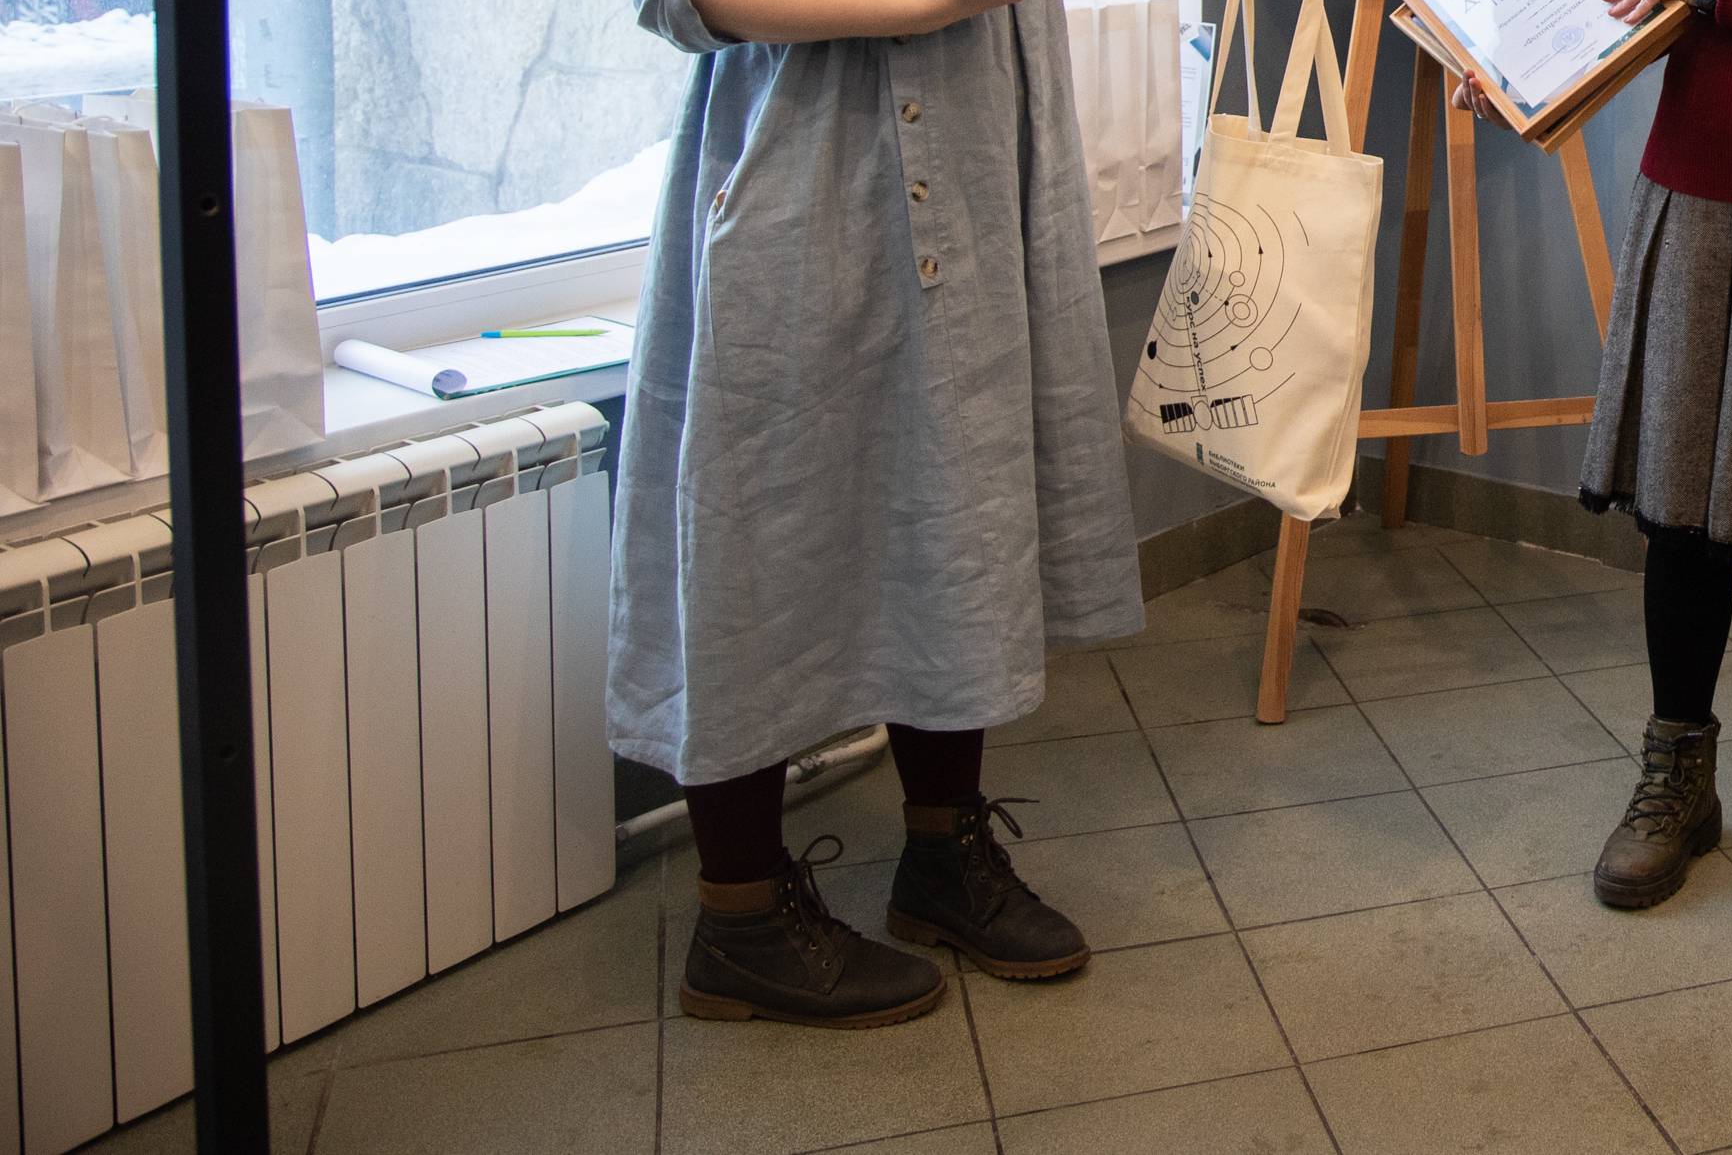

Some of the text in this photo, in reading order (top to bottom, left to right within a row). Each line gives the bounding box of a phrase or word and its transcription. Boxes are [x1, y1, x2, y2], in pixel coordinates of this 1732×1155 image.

[1186, 296, 1207, 392] курс на успех
[1247, 477, 1277, 488] РАЙОНА
